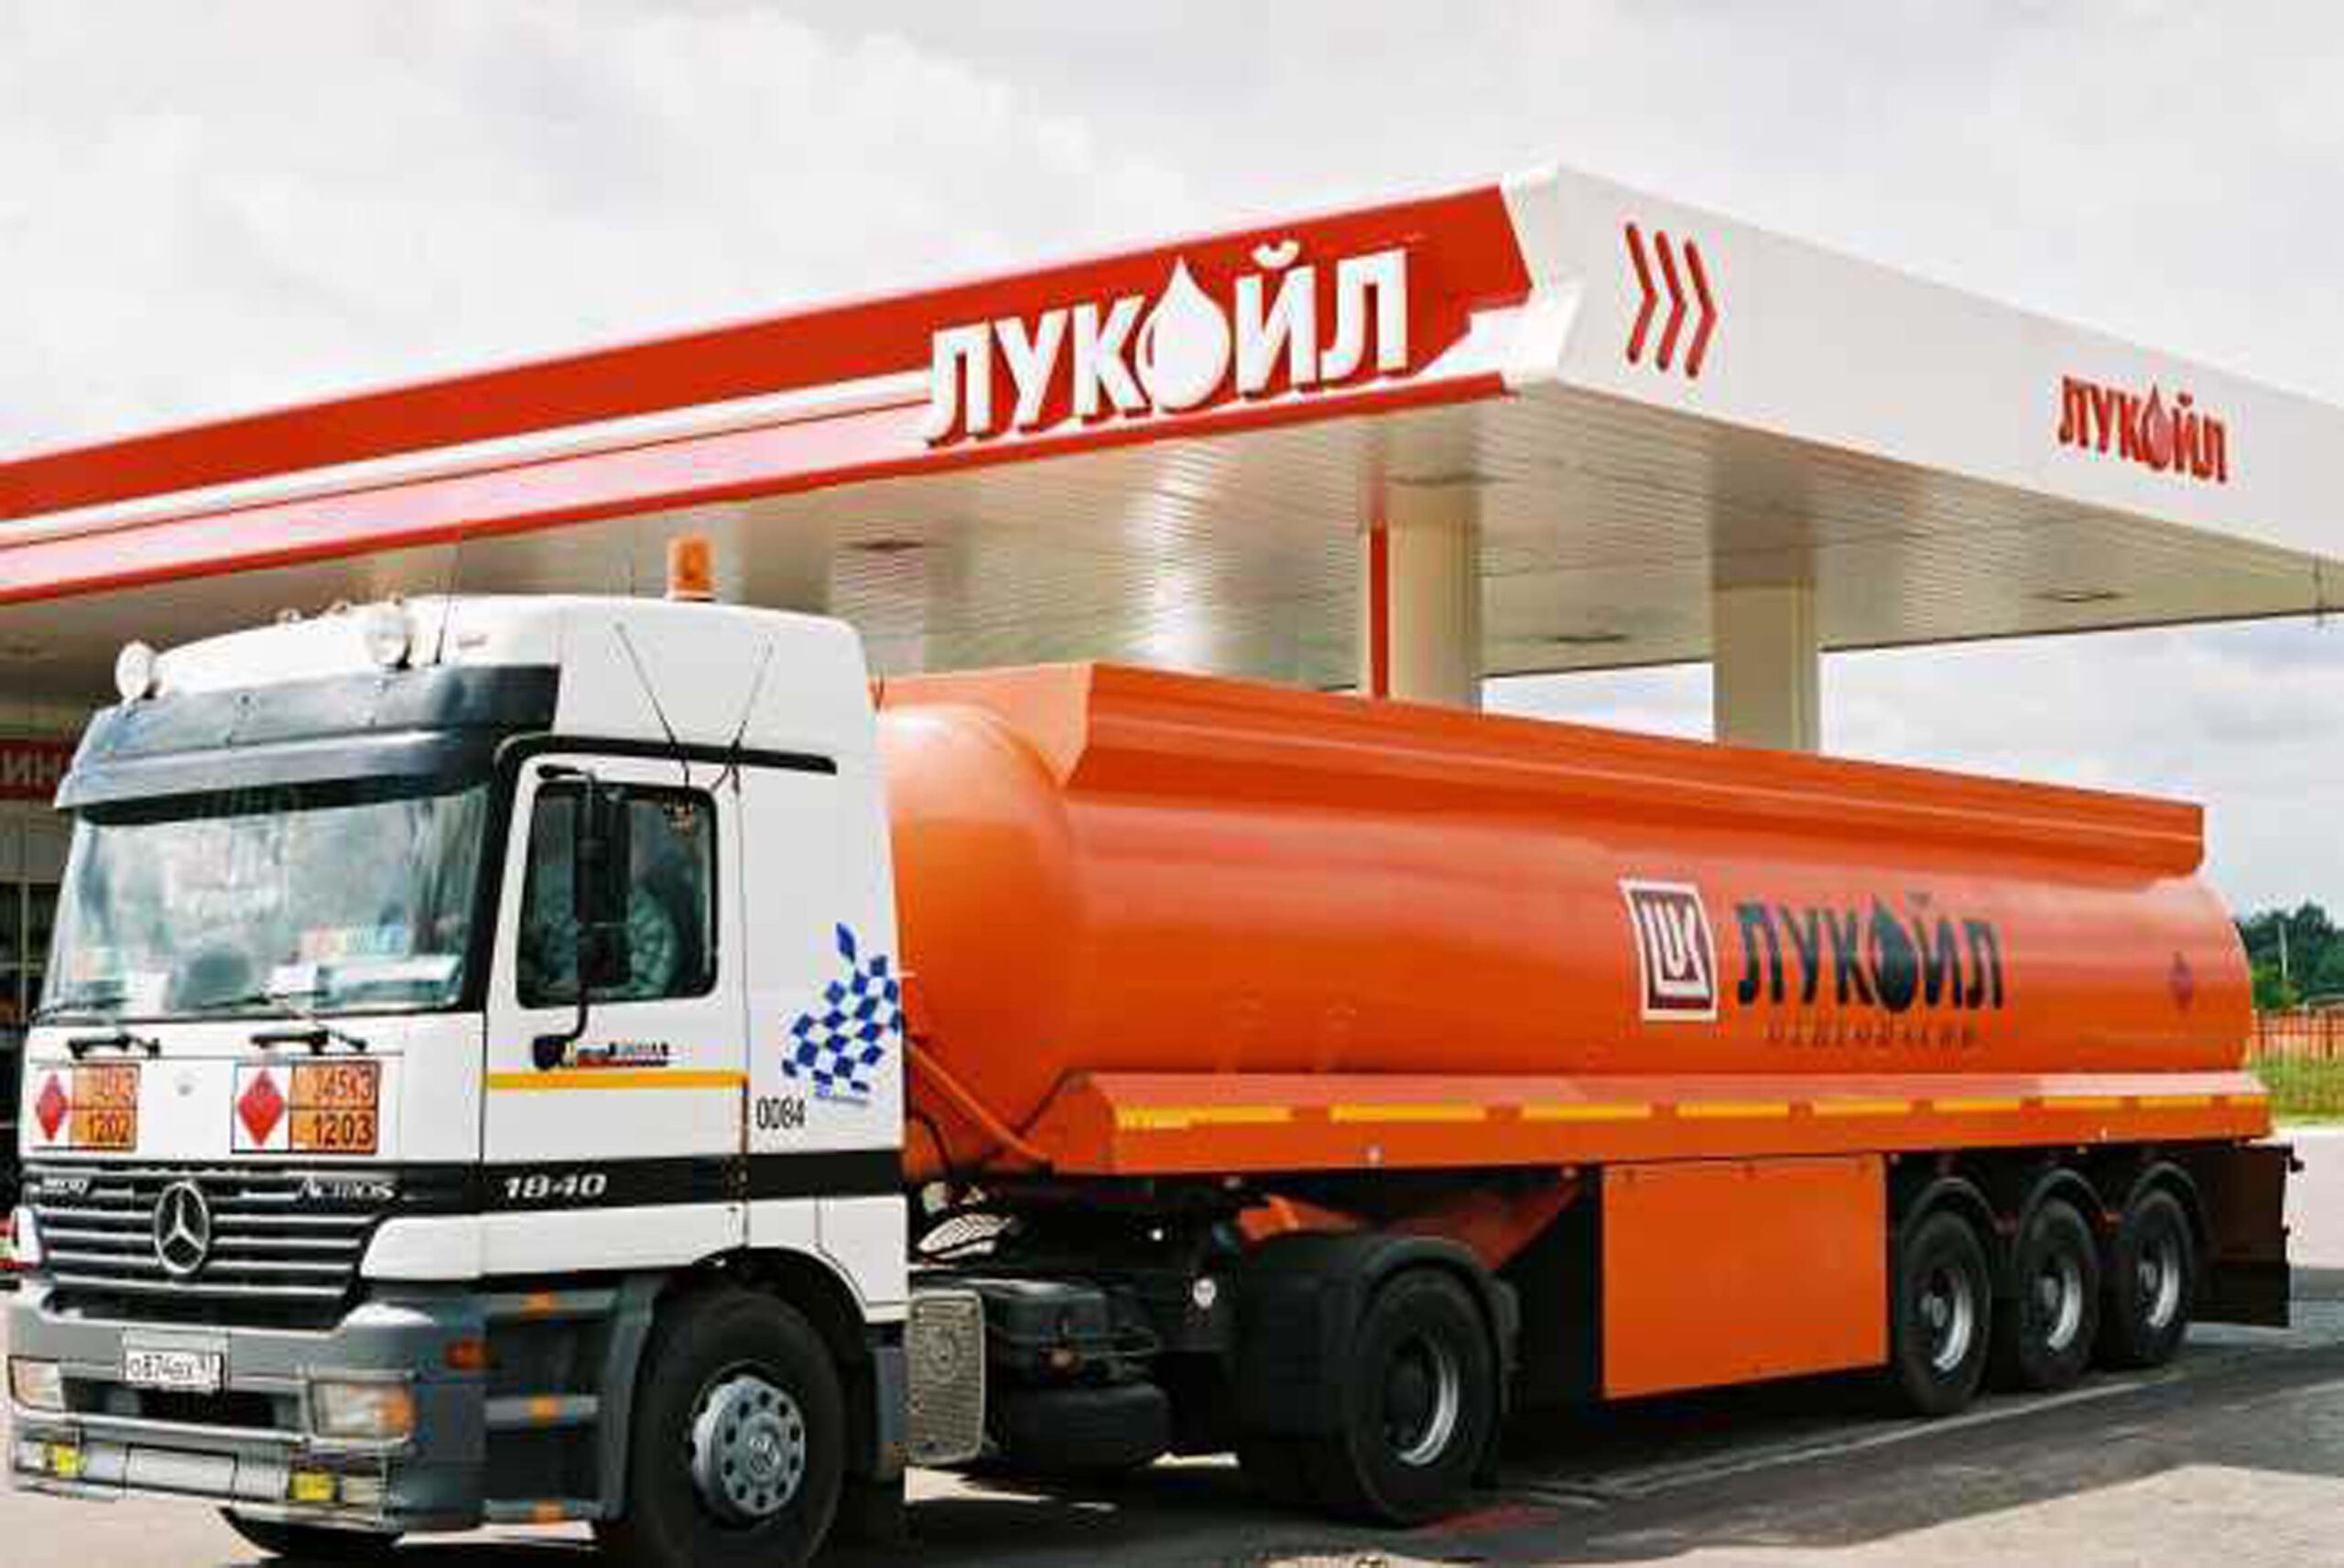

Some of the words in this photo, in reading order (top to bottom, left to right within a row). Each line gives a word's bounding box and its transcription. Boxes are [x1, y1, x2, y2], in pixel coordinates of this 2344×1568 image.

[925, 240, 1408, 446] ЛУКОЙЛ
[2059, 374, 2227, 483] ЛУКОЙЛ
[1736, 892, 2003, 1012] ЛУКОЙЛ
[313, 1114, 374, 1146] 1203
[505, 1173, 607, 1199] 1840
